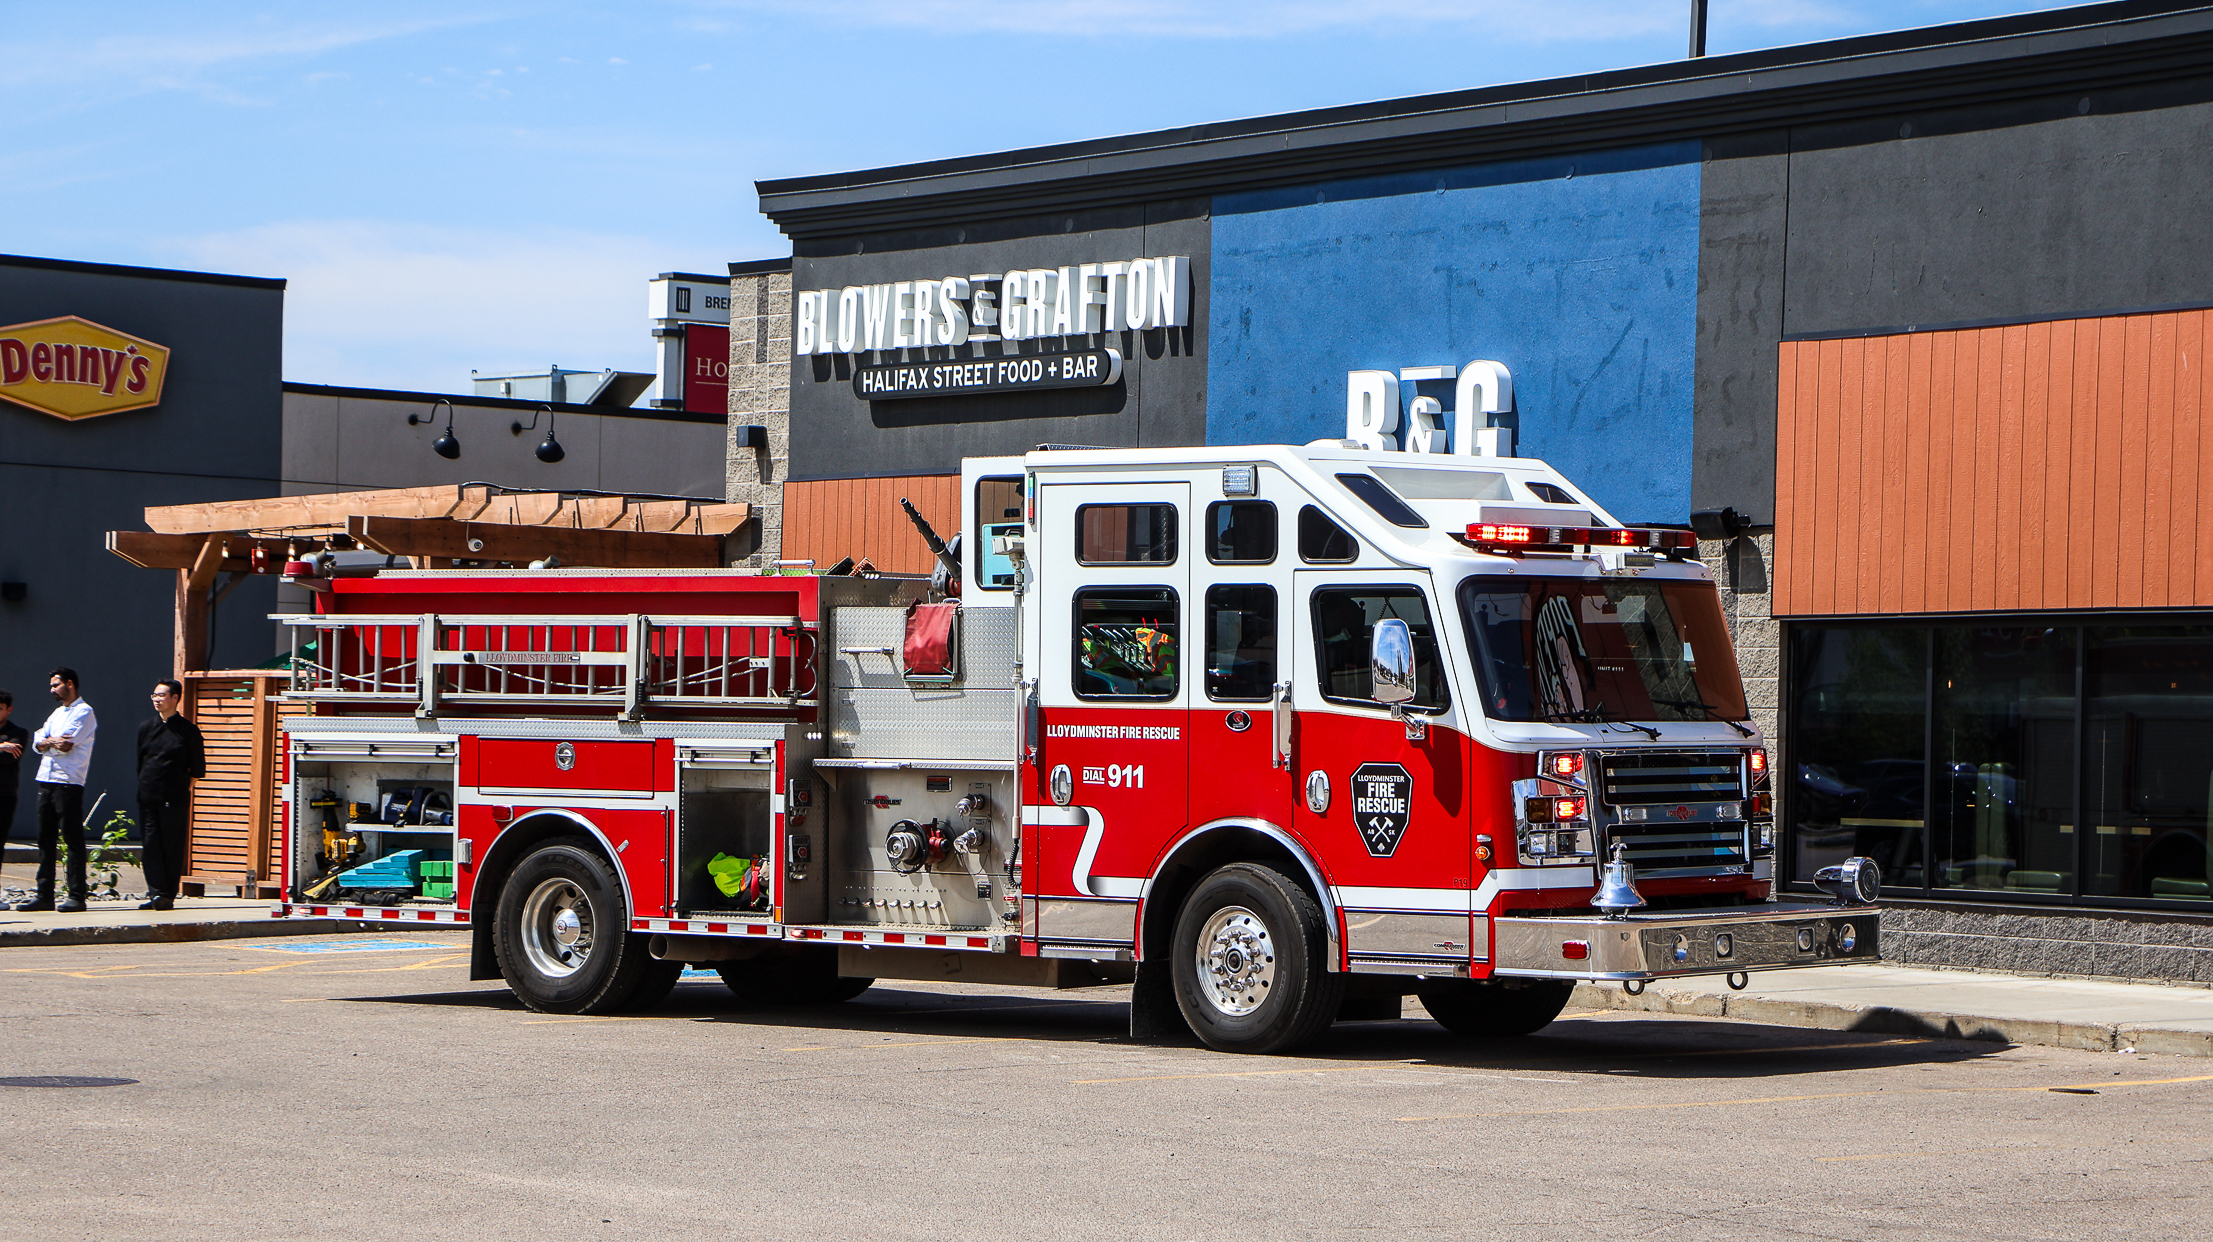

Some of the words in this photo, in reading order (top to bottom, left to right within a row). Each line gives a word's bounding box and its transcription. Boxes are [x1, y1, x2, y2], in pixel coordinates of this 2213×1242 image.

[797, 276, 970, 355] BLOWERS
[1001, 256, 1189, 340] GRAFTON
[0, 338, 152, 397] Denny's
[862, 367, 930, 393] HALIFAX
[933, 363, 994, 388] STREET
[998, 360, 1043, 384] FOOD
[1047, 365, 1058, 378] +
[1062, 355, 1098, 379] BAR
[1405, 396, 1447, 453] &
[1454, 360, 1513, 457] G
[486, 653, 552, 663] LLOYDMINSTER
[553, 654, 573, 663] FIRE
[1046, 725, 1119, 739] LLOYDMINSTER
[1120, 726, 1142, 739] FIRE
[1143, 727, 1181, 740] RESCUE
[1082, 769, 1105, 781] DIAL
[1107, 764, 1144, 788] 911
[1357, 775, 1405, 783] LLOYDMINSTER
[1367, 782, 1396, 798] FIRE
[1357, 797, 1405, 814] RESCUE
[1453, 877, 1468, 888] P19
